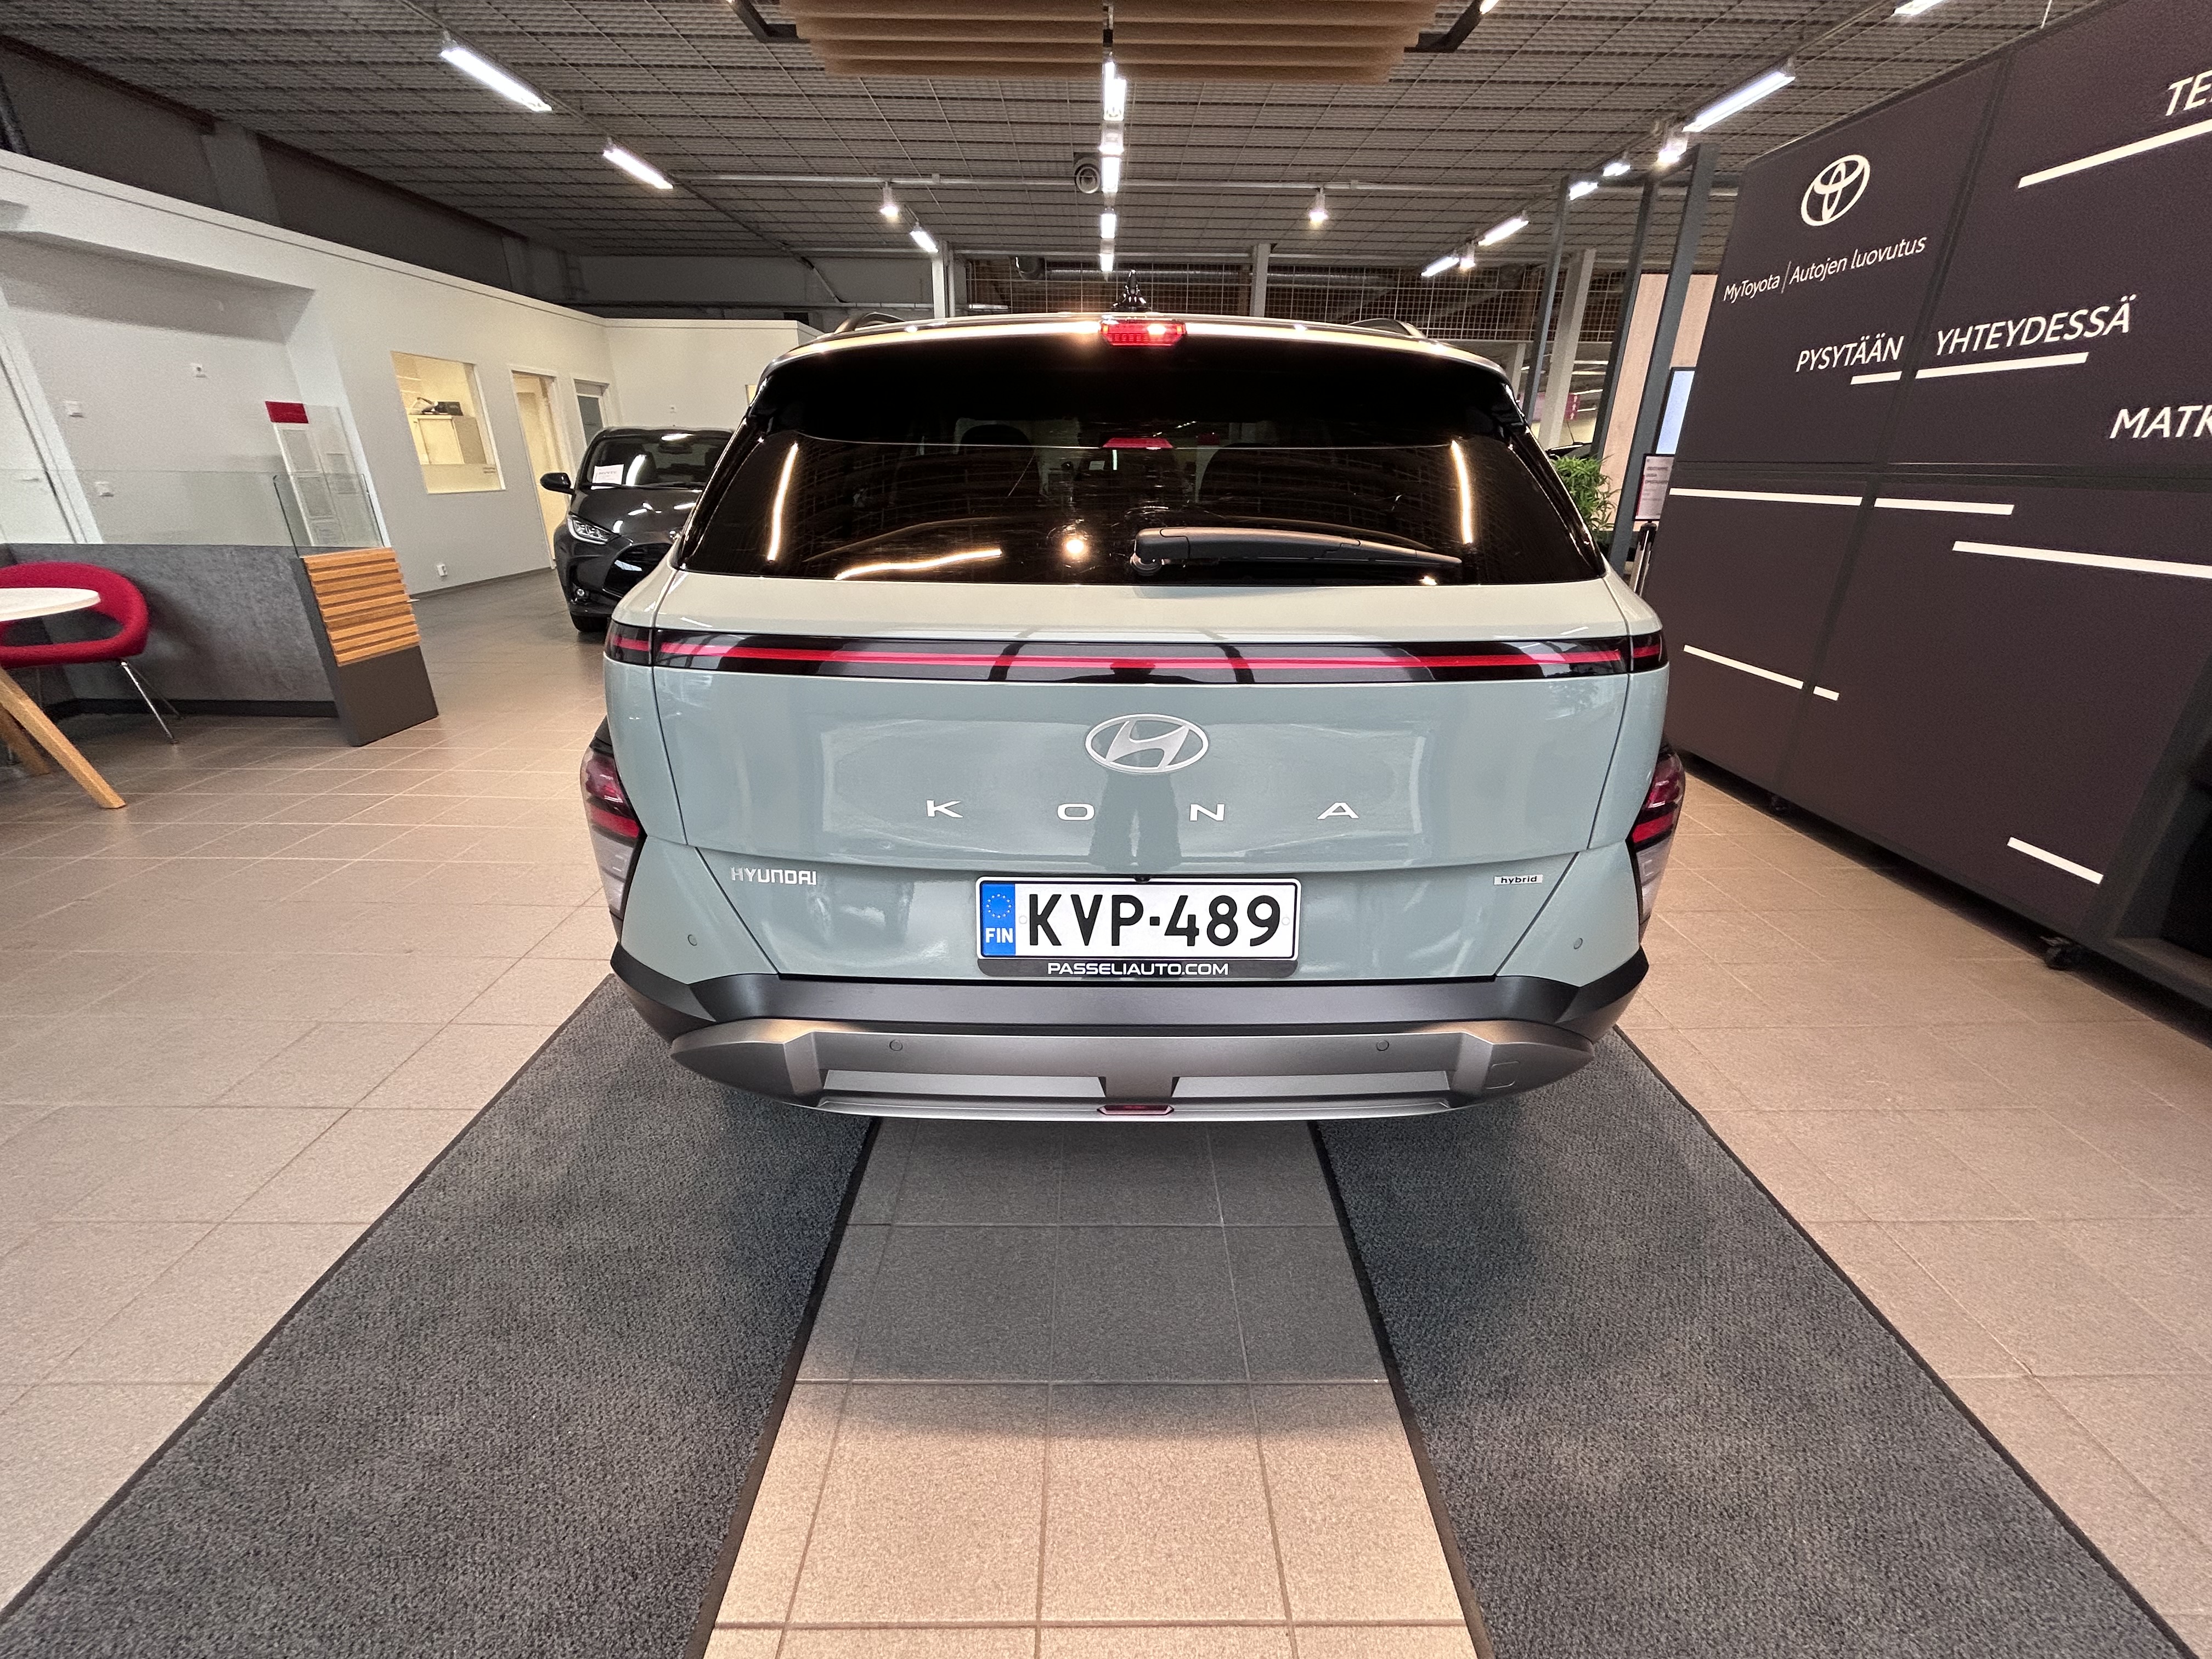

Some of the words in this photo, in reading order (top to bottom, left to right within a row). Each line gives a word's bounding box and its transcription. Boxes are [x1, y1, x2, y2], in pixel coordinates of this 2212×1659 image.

[2165, 69, 2212, 116] TE
[1723, 274, 1780, 303] MyToyota
[1789, 257, 1848, 285] Autojen
[1850, 236, 1927, 269] luovutus
[1796, 333, 1904, 373] PYSYTÄÄN
[1936, 294, 2137, 356] YHTEYDESSÄ
[730, 866, 817, 885] HYUNDAI
[1500, 876, 1537, 884] hybrid
[985, 927, 1014, 944] FIN
[1029, 894, 1281, 947] KVP-489
[1047, 962, 1229, 976] PASSELIAUTO.COM
